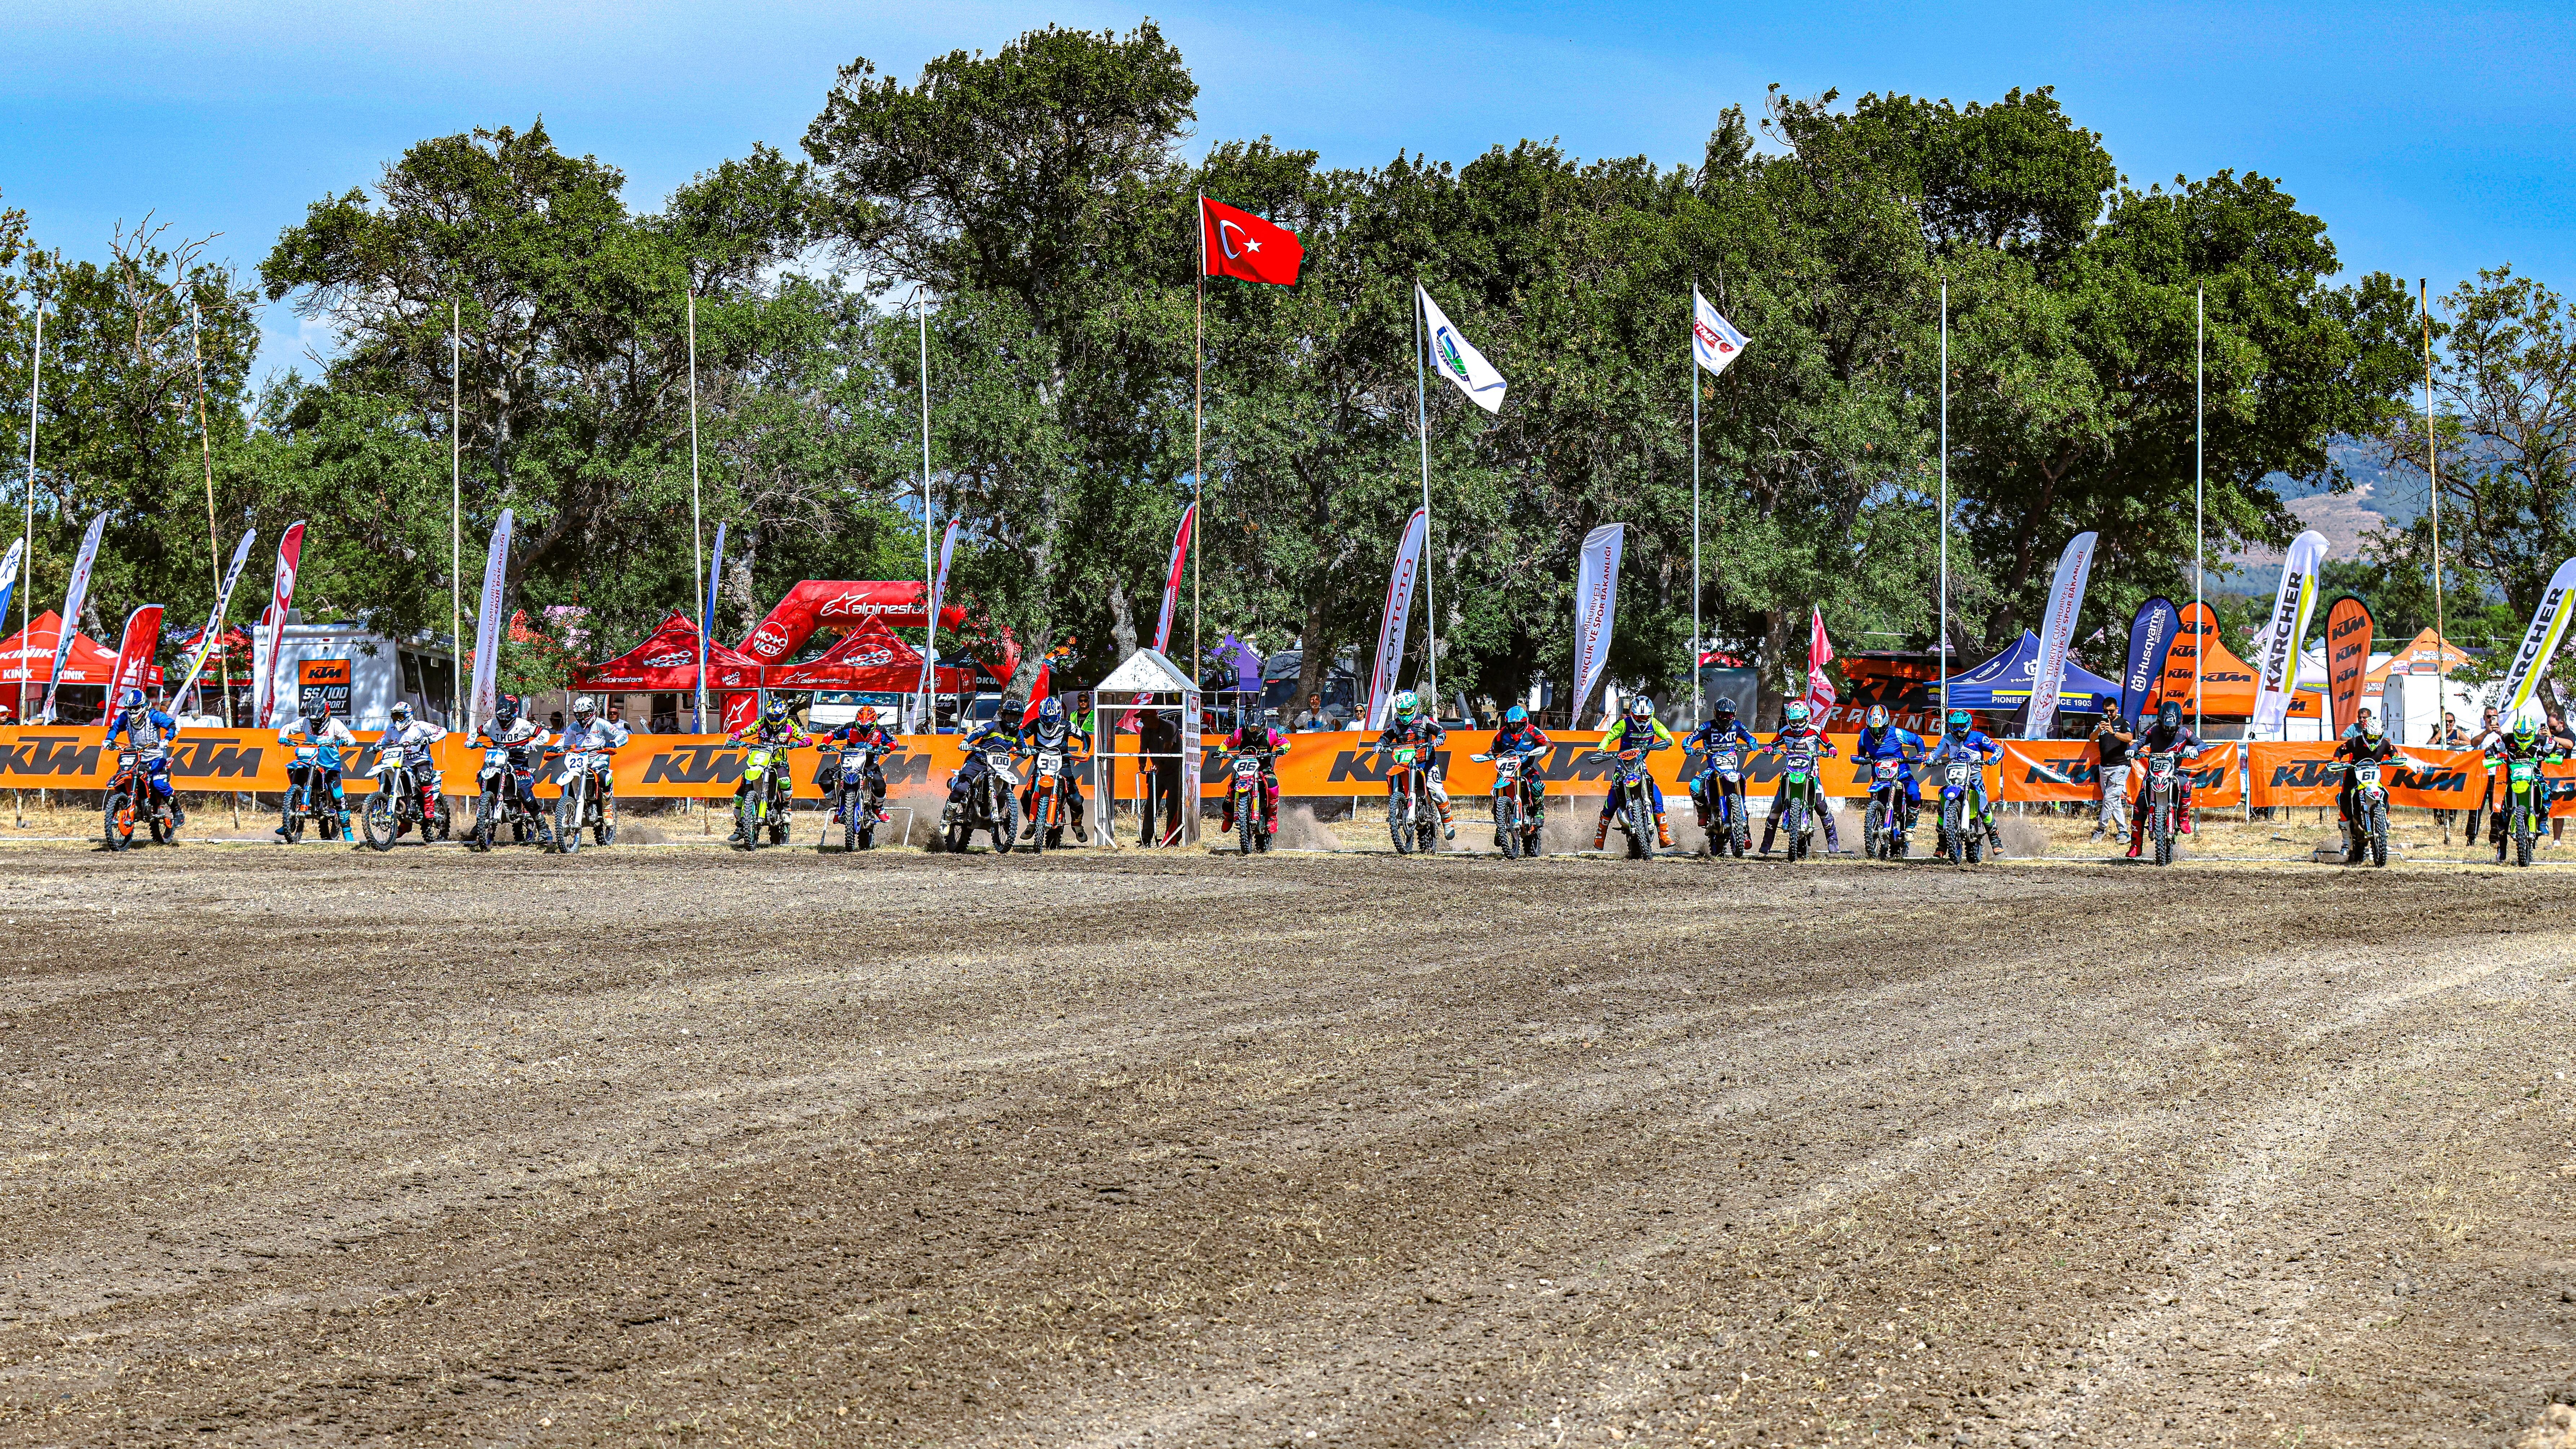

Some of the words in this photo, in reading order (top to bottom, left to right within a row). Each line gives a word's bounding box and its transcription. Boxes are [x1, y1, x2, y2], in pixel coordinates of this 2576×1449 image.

[1696, 323, 1718, 342] TMF
[1601, 546, 1611, 600] BAKANLIĞI
[2068, 551, 2084, 599] BAKANLIĞI
[1593, 603, 1605, 628] SPOR
[2063, 599, 2073, 625] SPOR
[2046, 640, 2058, 676] TÜRKİYE
[2053, 583, 2069, 640] CUMHURİYETİ
[2060, 627, 2067, 637] VE
[2156, 609, 2167, 644] MOTORCYCLES
[2177, 621, 2214, 635] KTM
[2265, 572, 2303, 692] KÄRCHER
[2332, 615, 2366, 641] KTM
[1589, 629, 1598, 646] VE
[2138, 608, 2163, 676] Husqvarna
[0, 648, 57, 659] KINIK
[2336, 643, 2361, 662] KTM
[2499, 587, 2564, 714] KÄRCHER
[2053, 639, 2065, 677] GENÇLİK
[3, 669, 33, 679] KINK
[307, 666, 342, 679] KTM
[1580, 648, 1591, 686] GENÇLİK
[2167, 668, 2194, 679] KTM
[2199, 672, 2251, 683] KTM
[2337, 667, 2358, 684] KTM
[303, 686, 349, 700] SS/100
[2165, 690, 2185, 698] KTM
[2339, 690, 2354, 703] KTM
[495, 733, 519, 741] THOR
[1711, 731, 1737, 742] FXR
[0, 736, 101, 775] KTM
[170, 737, 263, 777] KTM
[991, 756, 1009, 766] 100
[1787, 758, 1810, 767] 427
[569, 757, 583, 769] 23
[642, 745, 748, 783] KTM
[1040, 758, 1059, 771] 39
[1237, 762, 1257, 772] 86
[1498, 762, 1517, 772] 45
[2153, 762, 2170, 771] 96
[1948, 768, 1966, 779] 83
[2362, 771, 2376, 781] 61
